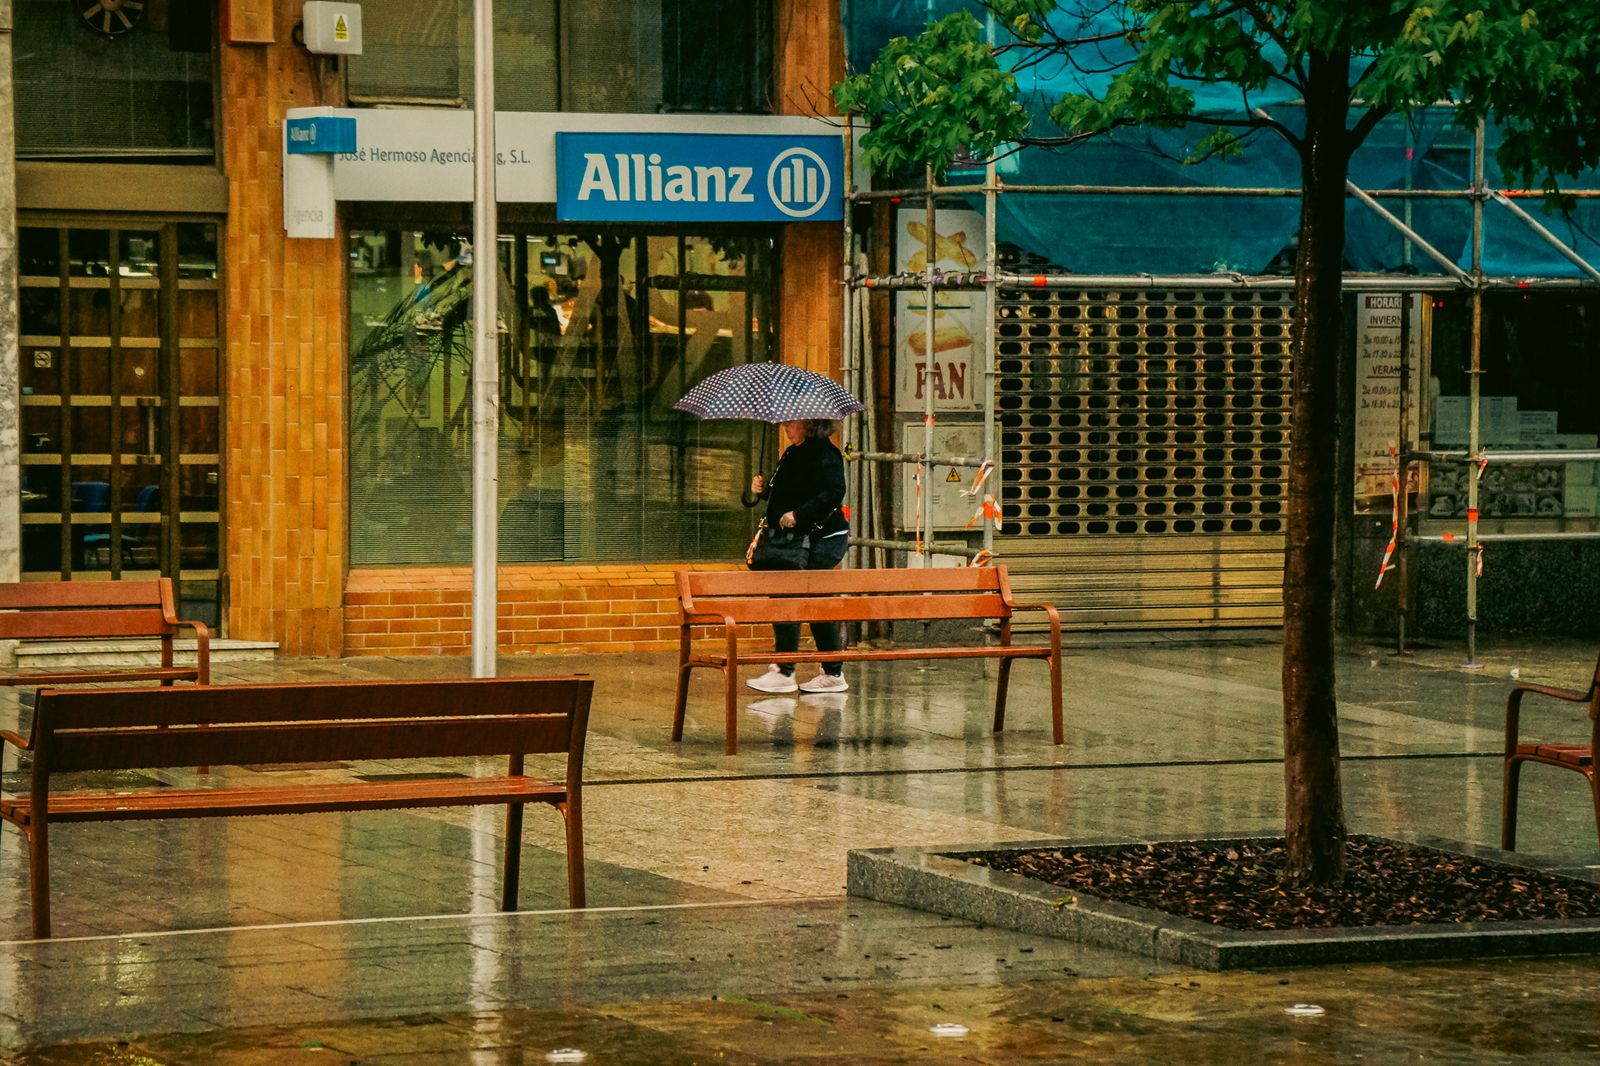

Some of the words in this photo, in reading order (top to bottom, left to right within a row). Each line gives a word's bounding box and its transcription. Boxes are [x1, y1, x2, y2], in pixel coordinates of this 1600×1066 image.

[338, 147, 366, 162] José
[370, 147, 427, 162] Hermoso
[510, 149, 531, 164] S.L.
[577, 152, 755, 202] Allianz
[1370, 297, 1402, 308] HORARI
[1370, 315, 1402, 325] INVIERN
[1372, 364, 1401, 375] VERAN
[914, 361, 967, 400] PAN
